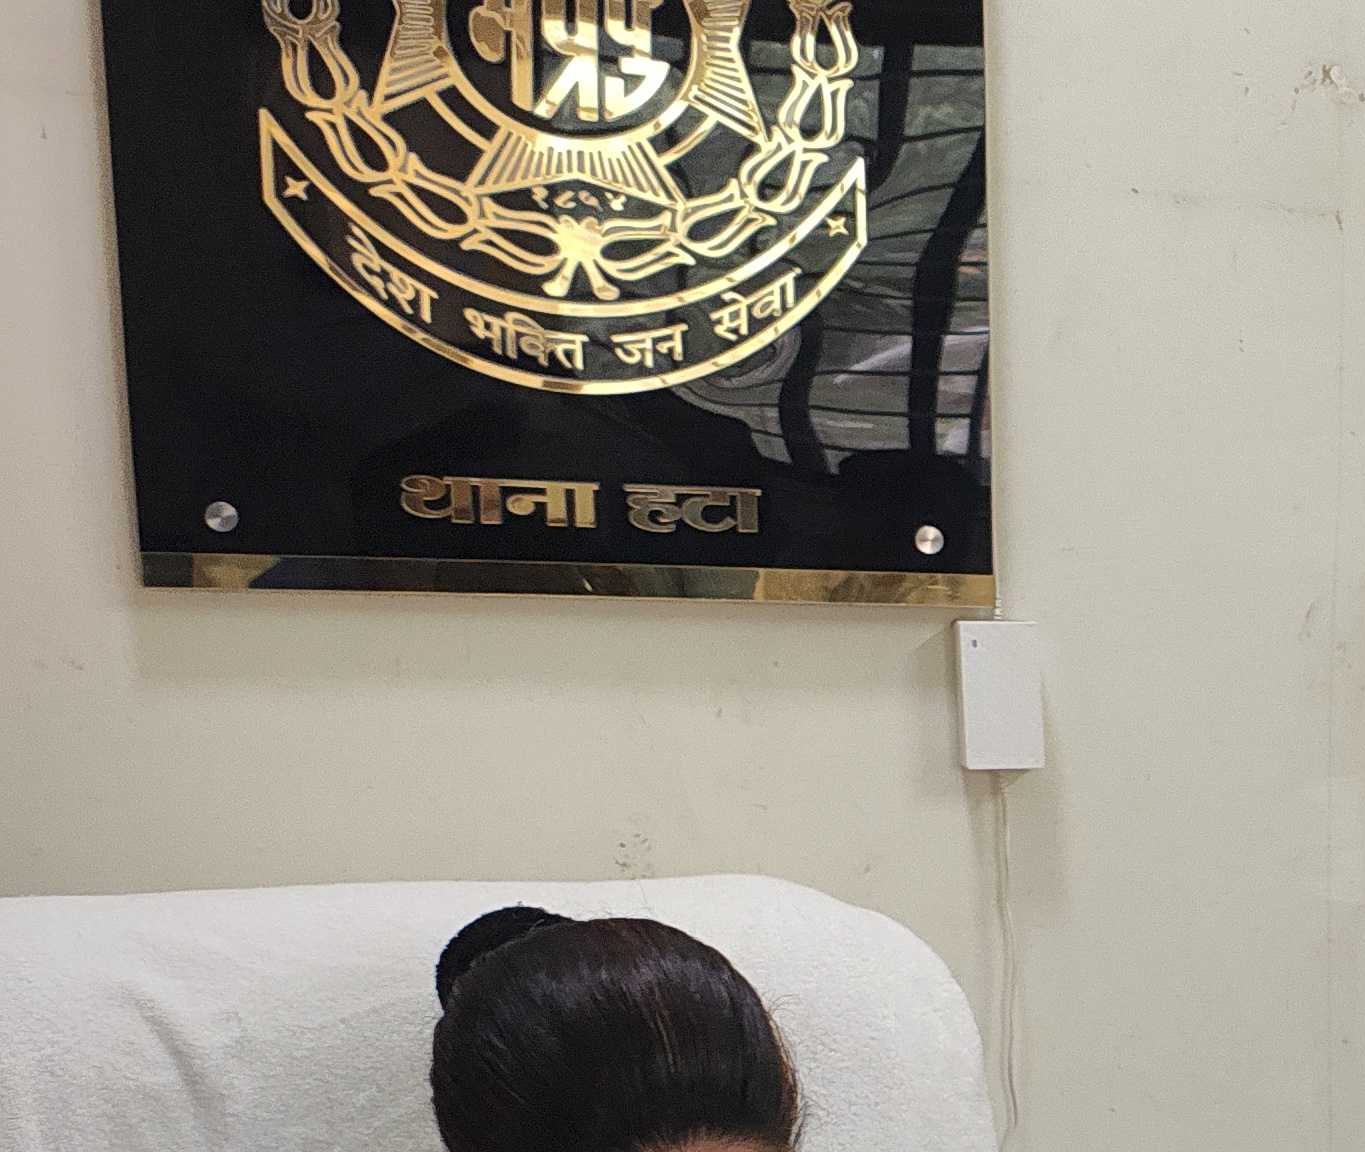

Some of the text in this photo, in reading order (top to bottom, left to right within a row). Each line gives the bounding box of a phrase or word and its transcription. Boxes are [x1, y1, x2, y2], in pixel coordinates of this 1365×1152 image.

[346, 224, 801, 374] देश भक्ति जन सेवा
[399, 474, 762, 535] थाना हटा
